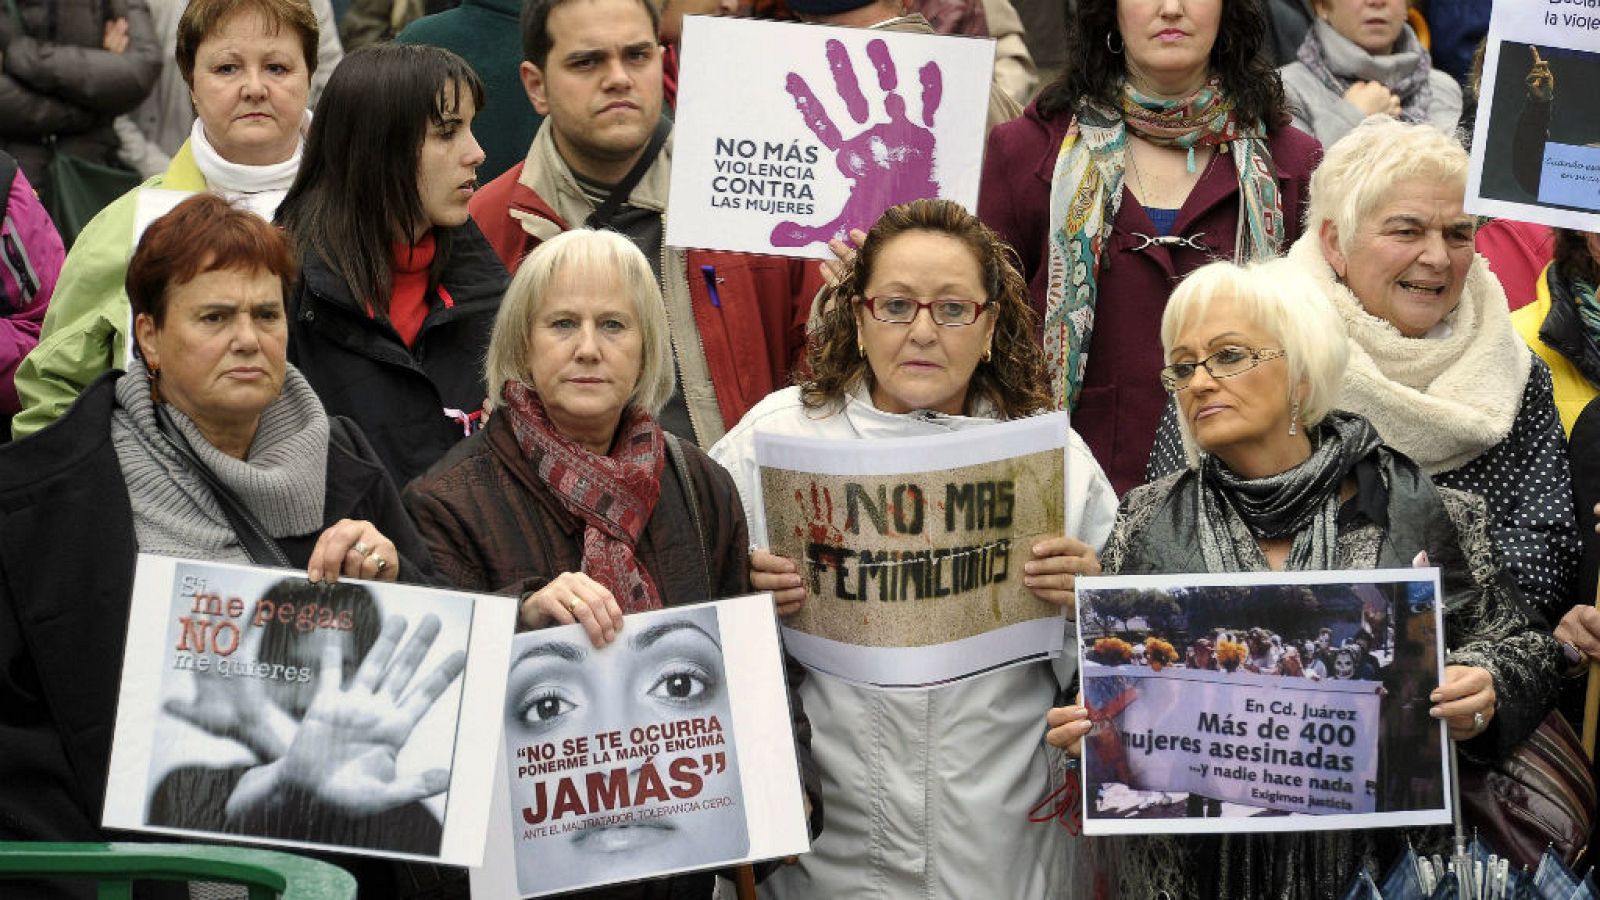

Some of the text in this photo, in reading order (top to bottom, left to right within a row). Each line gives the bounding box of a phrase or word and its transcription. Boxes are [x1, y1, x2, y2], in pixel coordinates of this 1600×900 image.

[1545, 10, 1558, 25] la
[716, 137, 818, 164] NO MÁS
[714, 159, 815, 180] VIOLENCIA
[712, 176, 814, 200] CONTRA
[711, 195, 814, 214] LAS MUJERES
[844, 480, 1016, 536] NO MAS
[191, 591, 354, 633] me pegas
[176, 616, 240, 657] NO
[173, 654, 312, 682] me quieres
[1245, 698, 1358, 721] En Cd. Juárez
[562, 736, 589, 756] SE
[595, 730, 623, 750] TE
[629, 715, 723, 745] OCURRA
[1197, 712, 1356, 748] Más de 400
[518, 734, 726, 778] PONERME LA MANO ENCIMA
[1208, 741, 1355, 773] asesinadas
[1213, 765, 1257, 781] nadie
[1263, 769, 1303, 787] hace
[1309, 777, 1354, 794] nada
[1251, 788, 1353, 811] Exigimos justicia
[523, 827, 548, 841] ANTE
[549, 825, 560, 836] EL
[638, 802, 701, 821] TOLERANCIA
